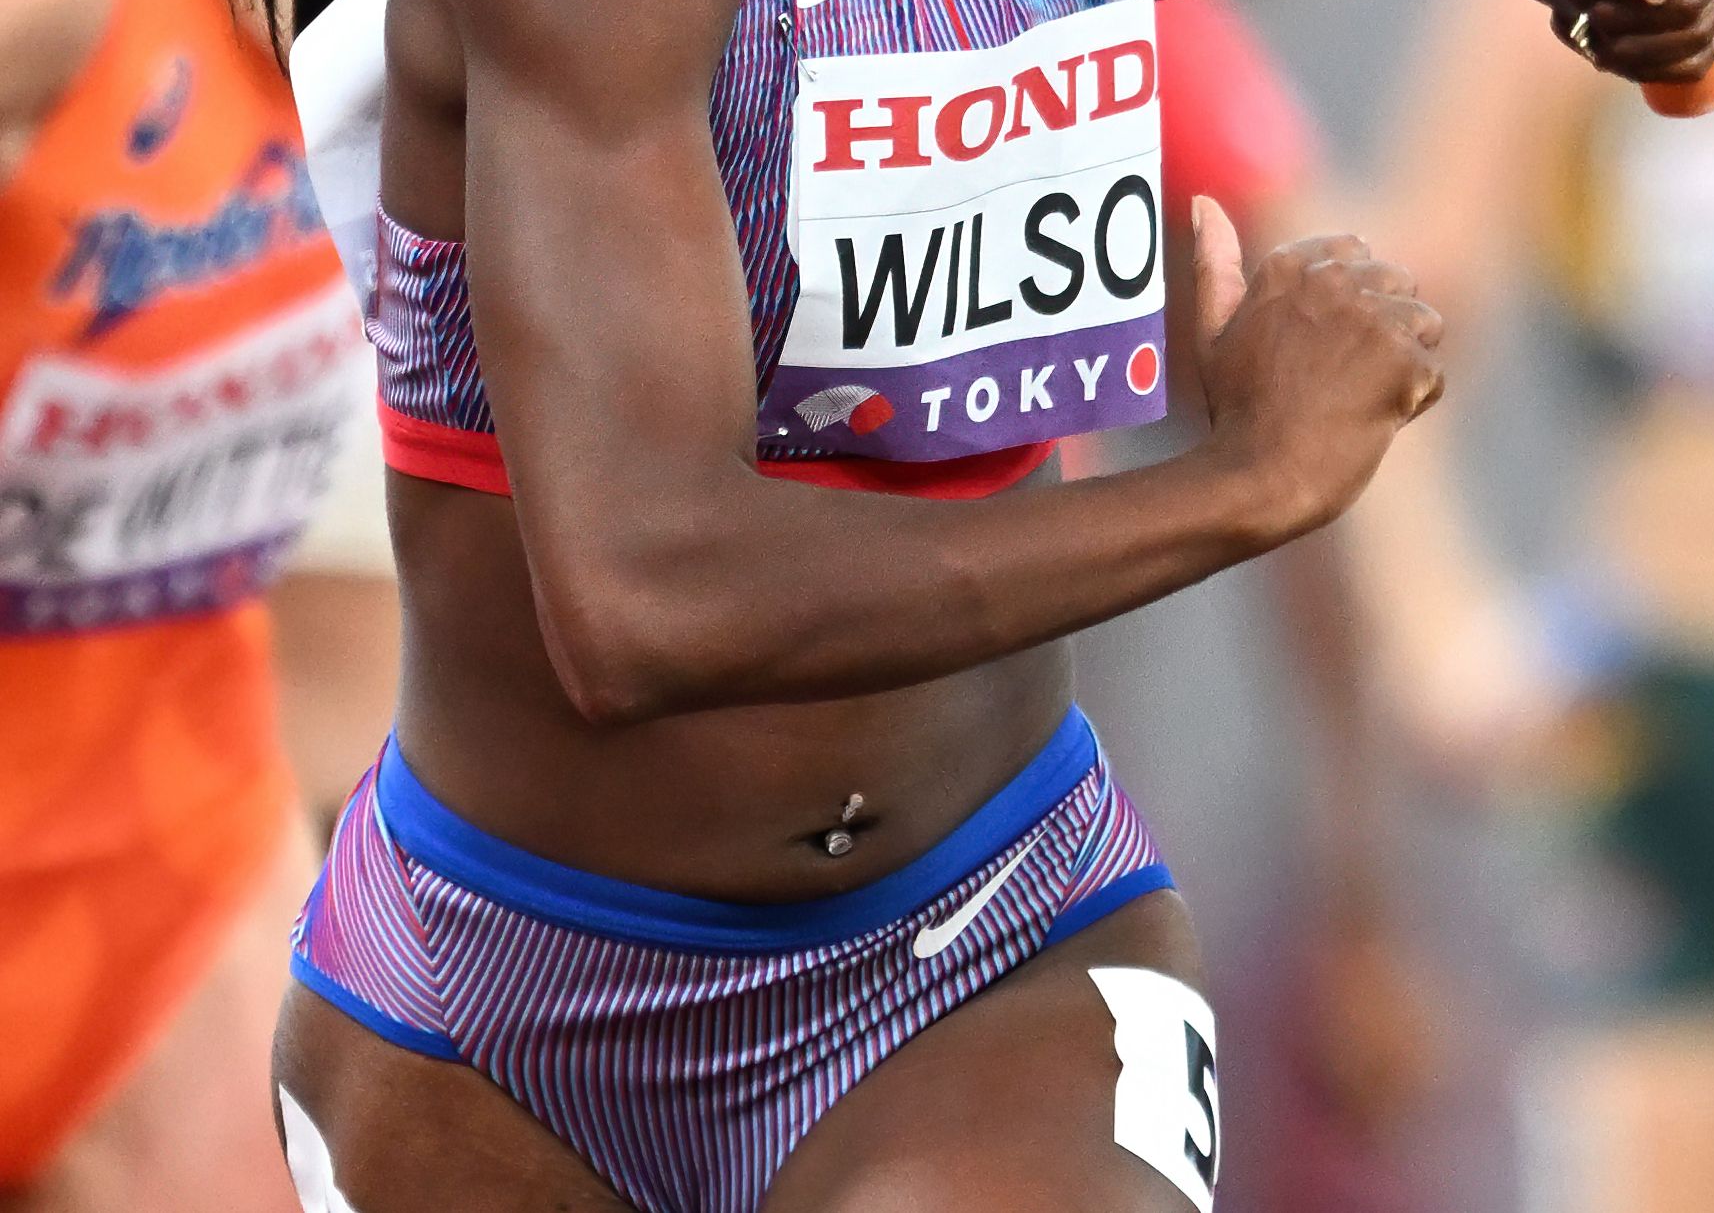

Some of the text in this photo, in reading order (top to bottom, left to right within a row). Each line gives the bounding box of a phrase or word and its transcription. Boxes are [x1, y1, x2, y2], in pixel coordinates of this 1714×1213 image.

[813, 39, 1159, 173] HOND
[834, 174, 1157, 350] WILSO
[919, 343, 1160, 433] TOKYO
[1183, 1019, 1217, 1200] 5
